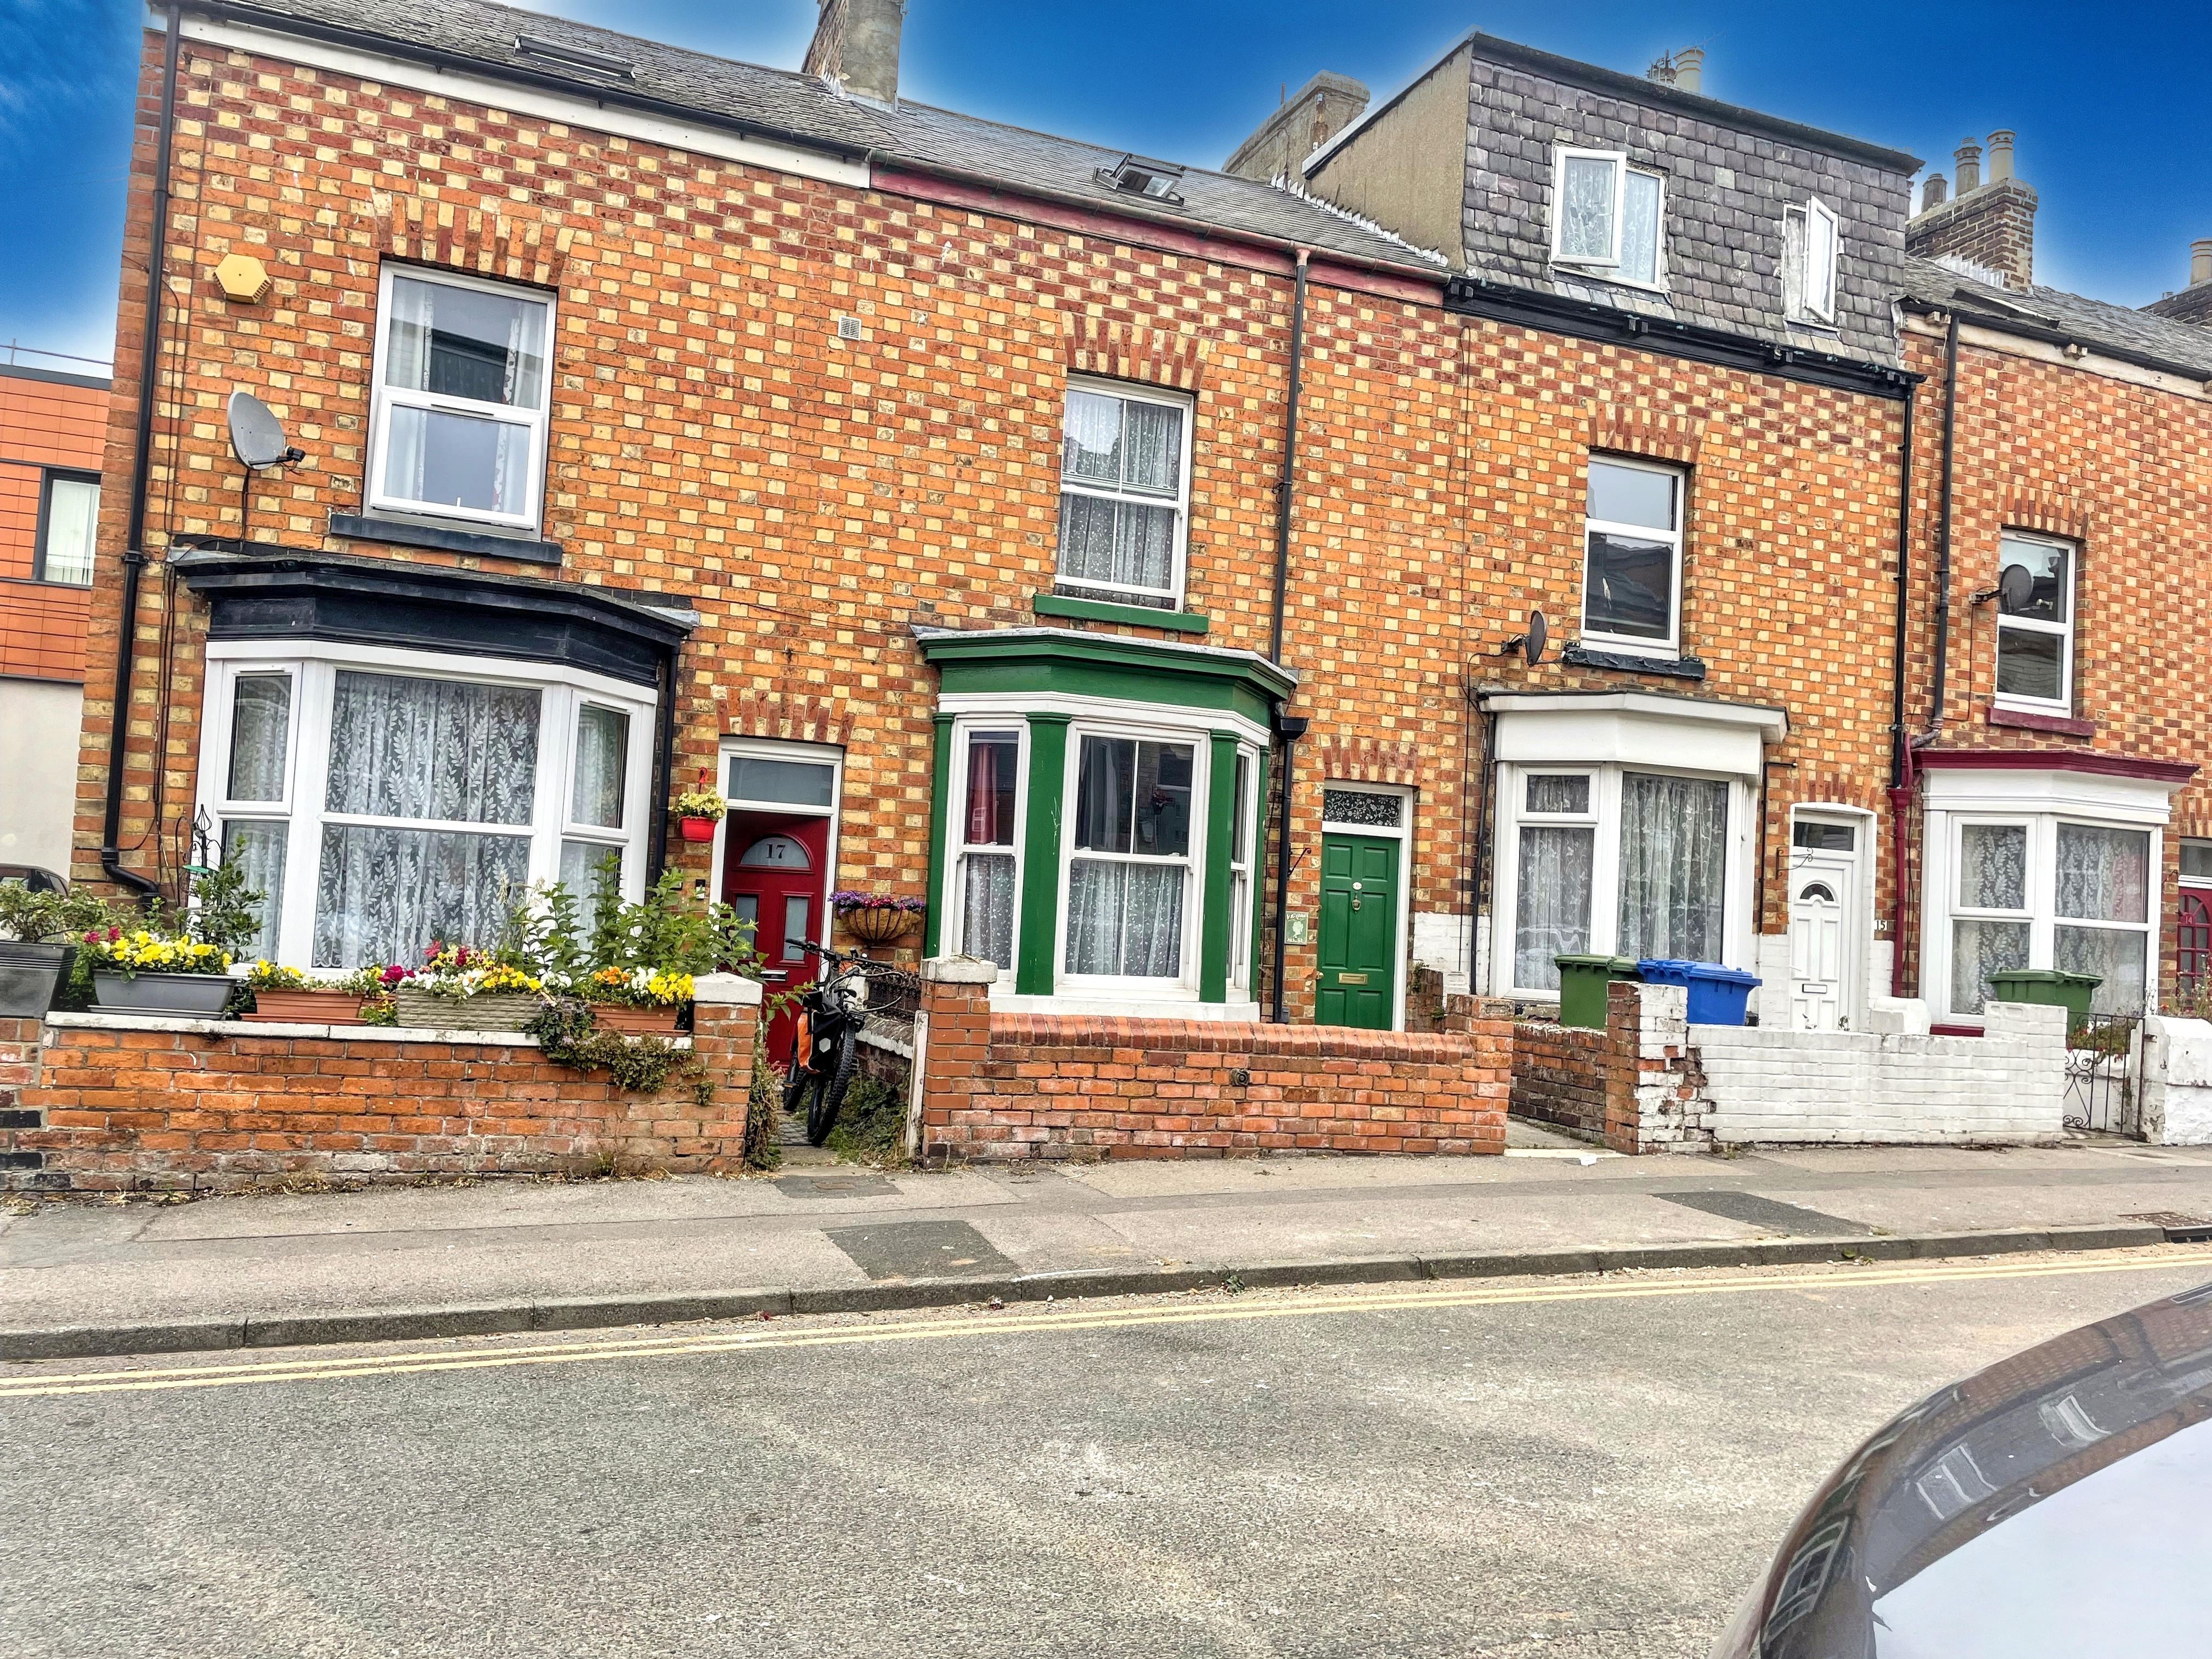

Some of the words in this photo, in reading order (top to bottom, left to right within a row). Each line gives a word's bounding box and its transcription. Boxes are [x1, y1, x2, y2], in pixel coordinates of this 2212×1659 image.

[766, 844, 786, 859] 17
[1877, 920, 1886, 930] 15
[2185, 916, 2192, 924] 14
